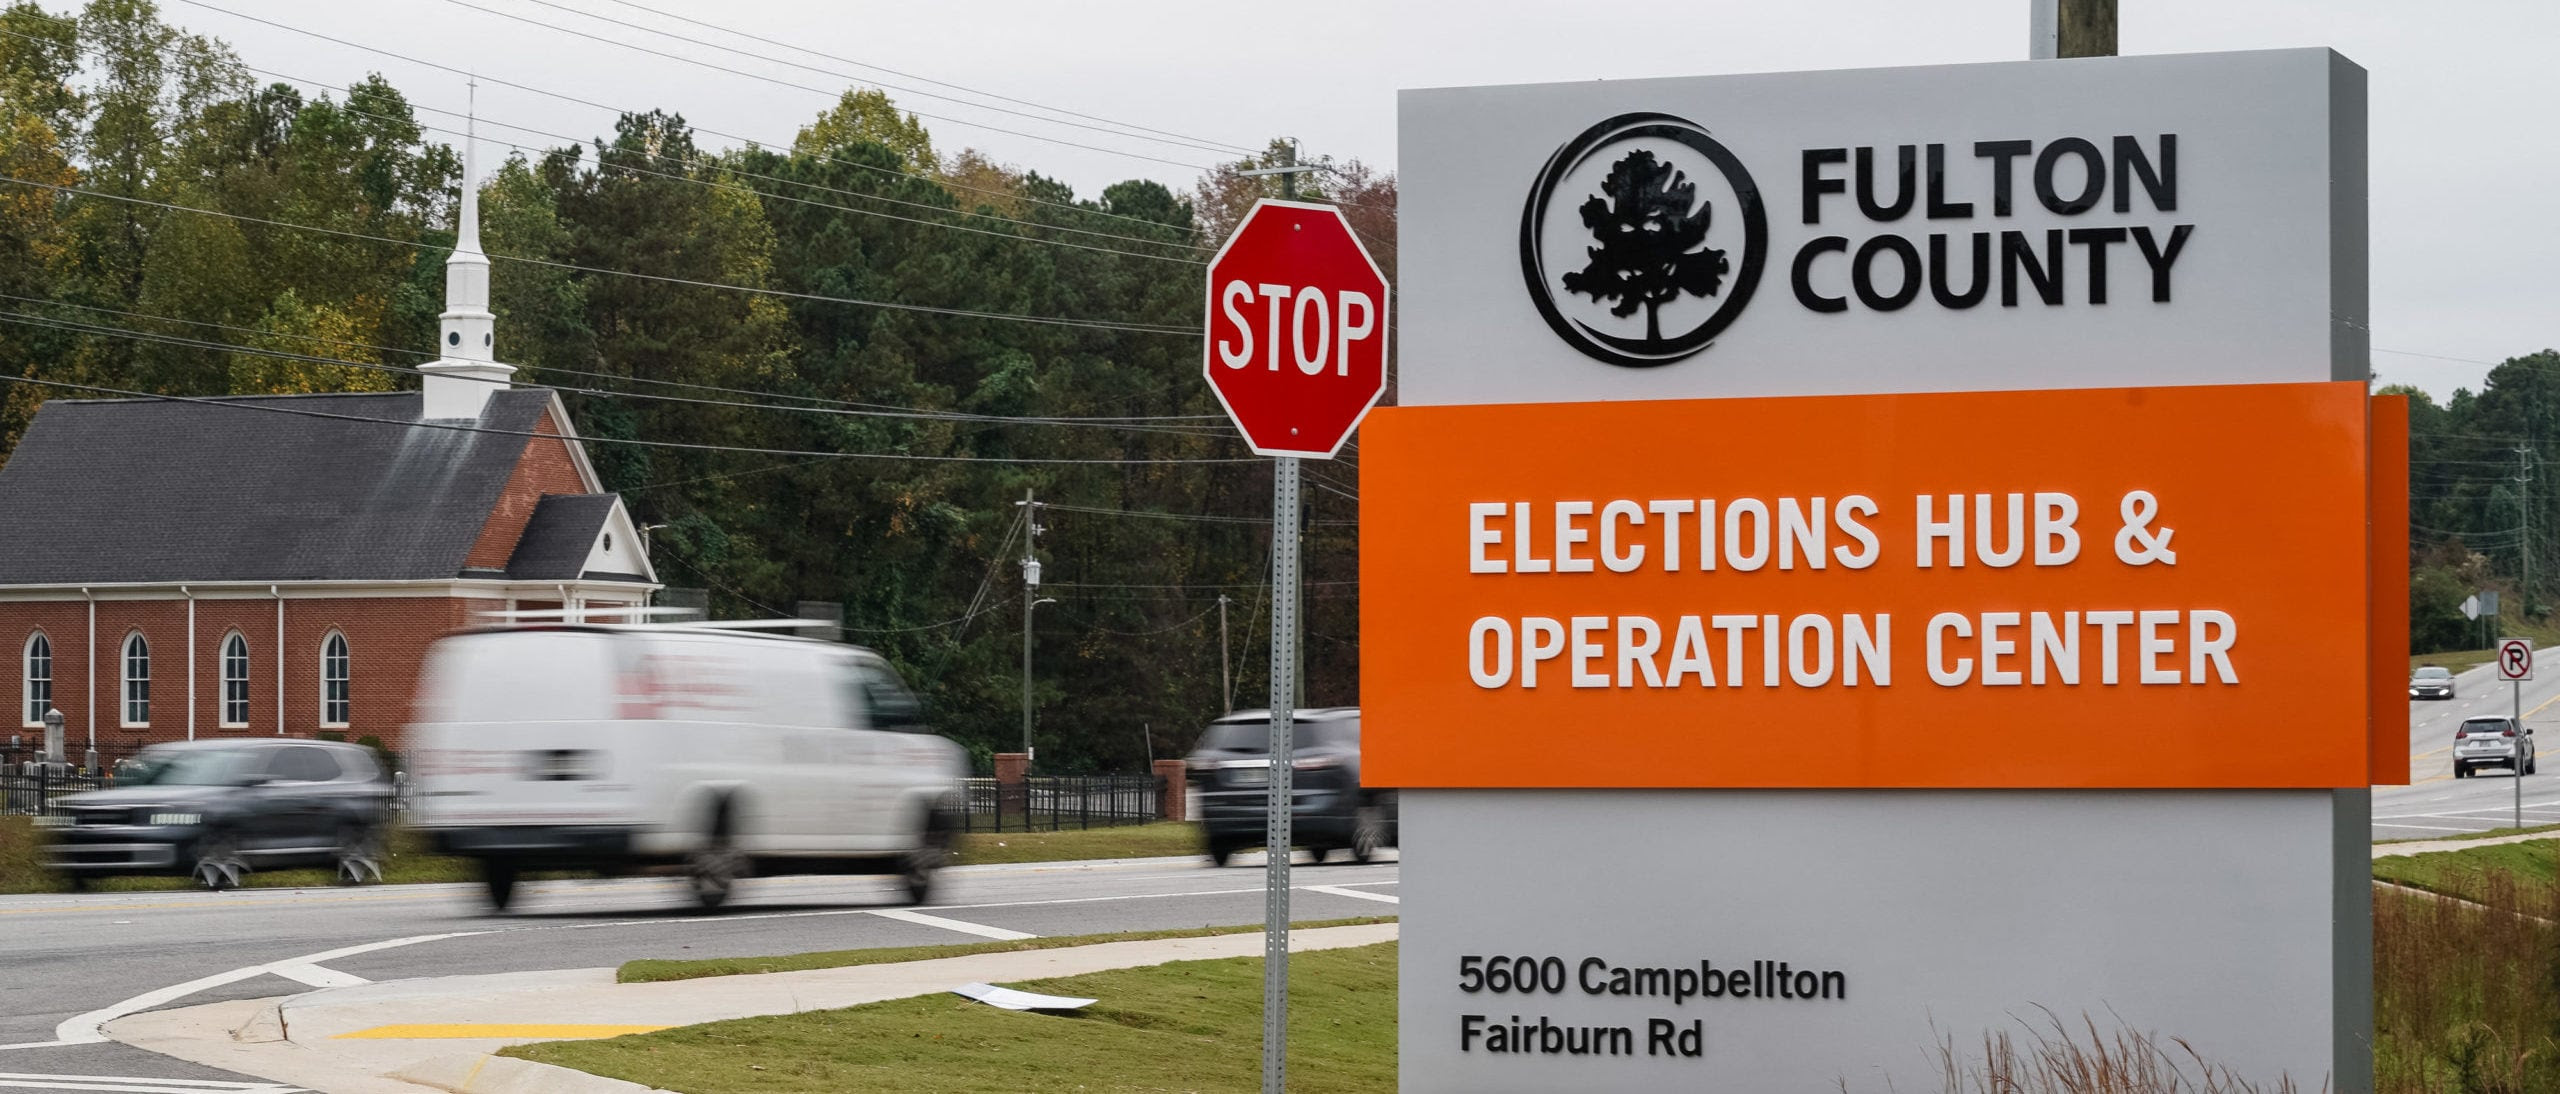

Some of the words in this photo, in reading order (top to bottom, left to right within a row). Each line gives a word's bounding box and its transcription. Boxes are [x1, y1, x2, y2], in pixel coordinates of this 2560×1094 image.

[1801, 132, 2178, 226] FULTON
[1789, 223, 2196, 314] COUNTY
[1218, 279, 1375, 378] STOP
[1468, 494, 1881, 574] ELECTIONS
[1915, 491, 2082, 569] HUB
[2113, 488, 2178, 566] &
[1468, 612, 1893, 690] OPERATION
[1925, 608, 2240, 688] CENTER
[1458, 954, 1567, 996] 5600
[1578, 955, 1847, 1006] Campbellton
[1461, 1014, 1634, 1057] Fairburn
[1648, 1017, 1704, 1058] Rd
